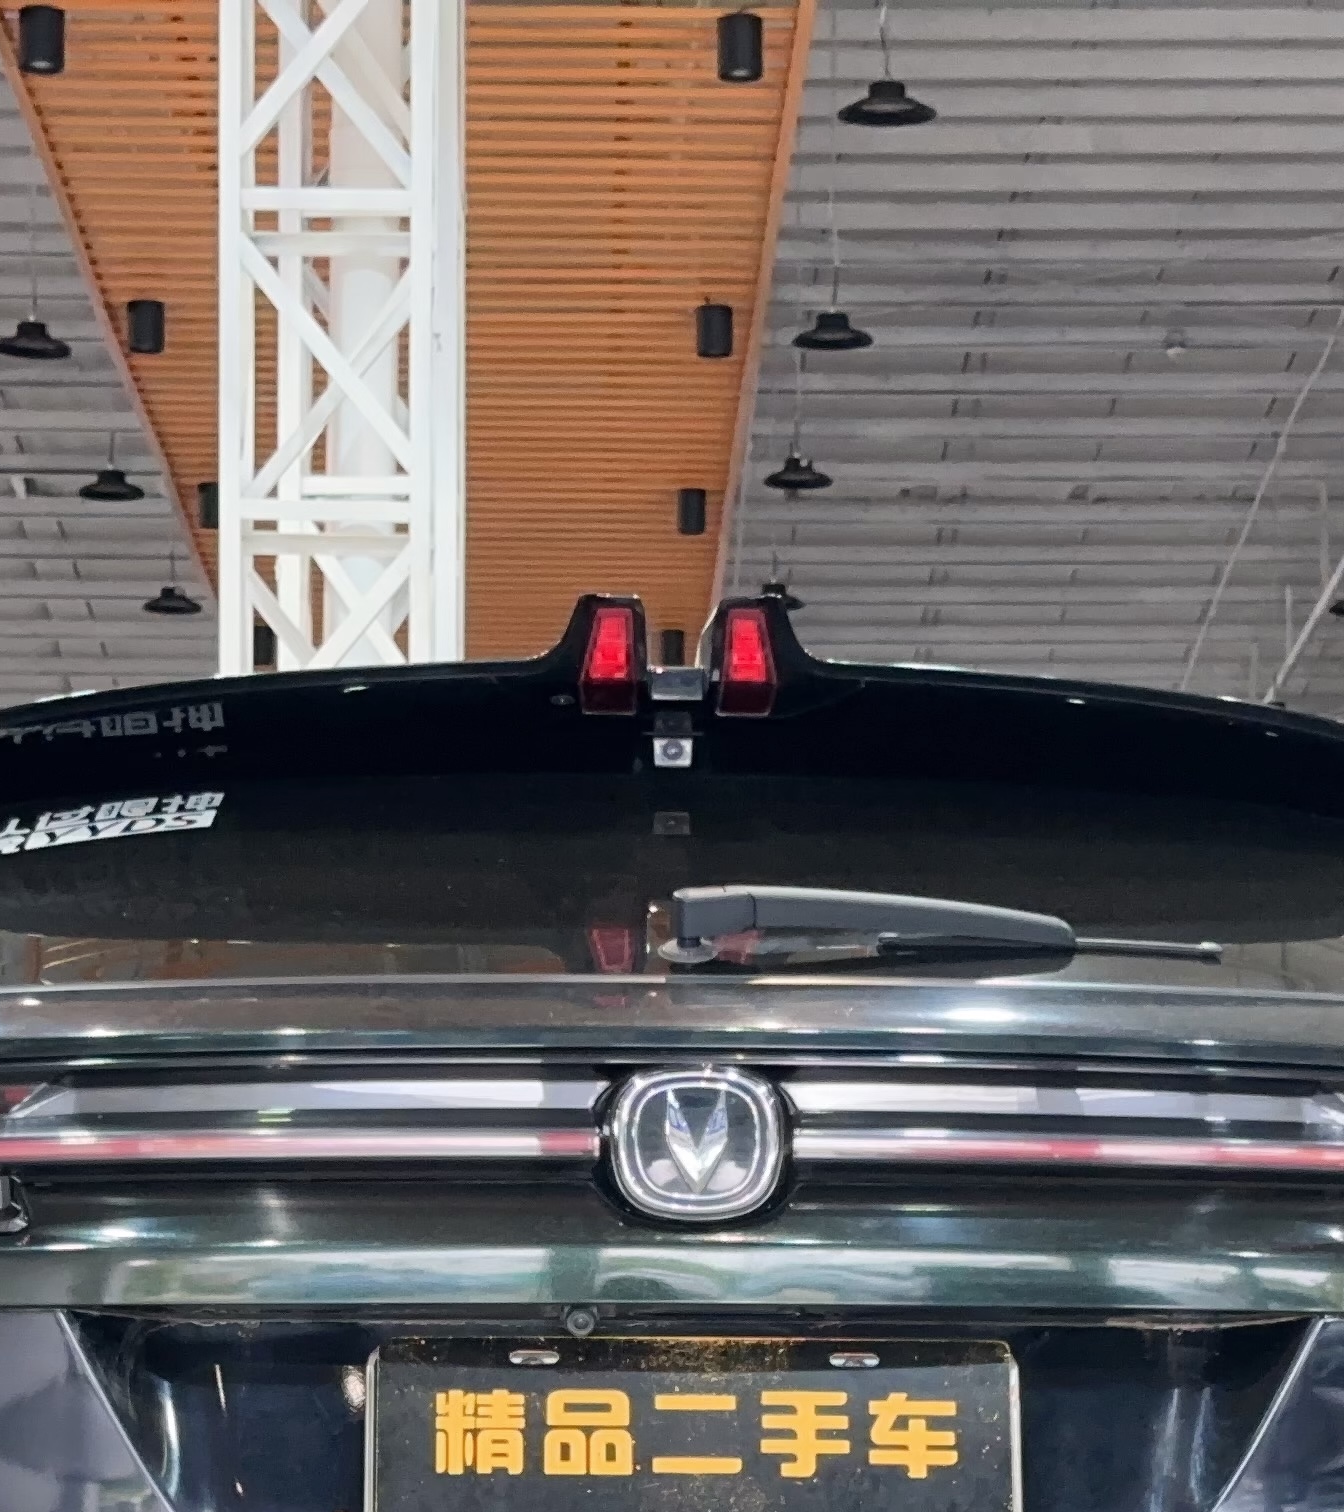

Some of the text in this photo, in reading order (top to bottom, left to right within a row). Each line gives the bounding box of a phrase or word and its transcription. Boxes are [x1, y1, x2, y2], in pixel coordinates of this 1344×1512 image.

[434, 1389, 960, 1479] 精品二手车
